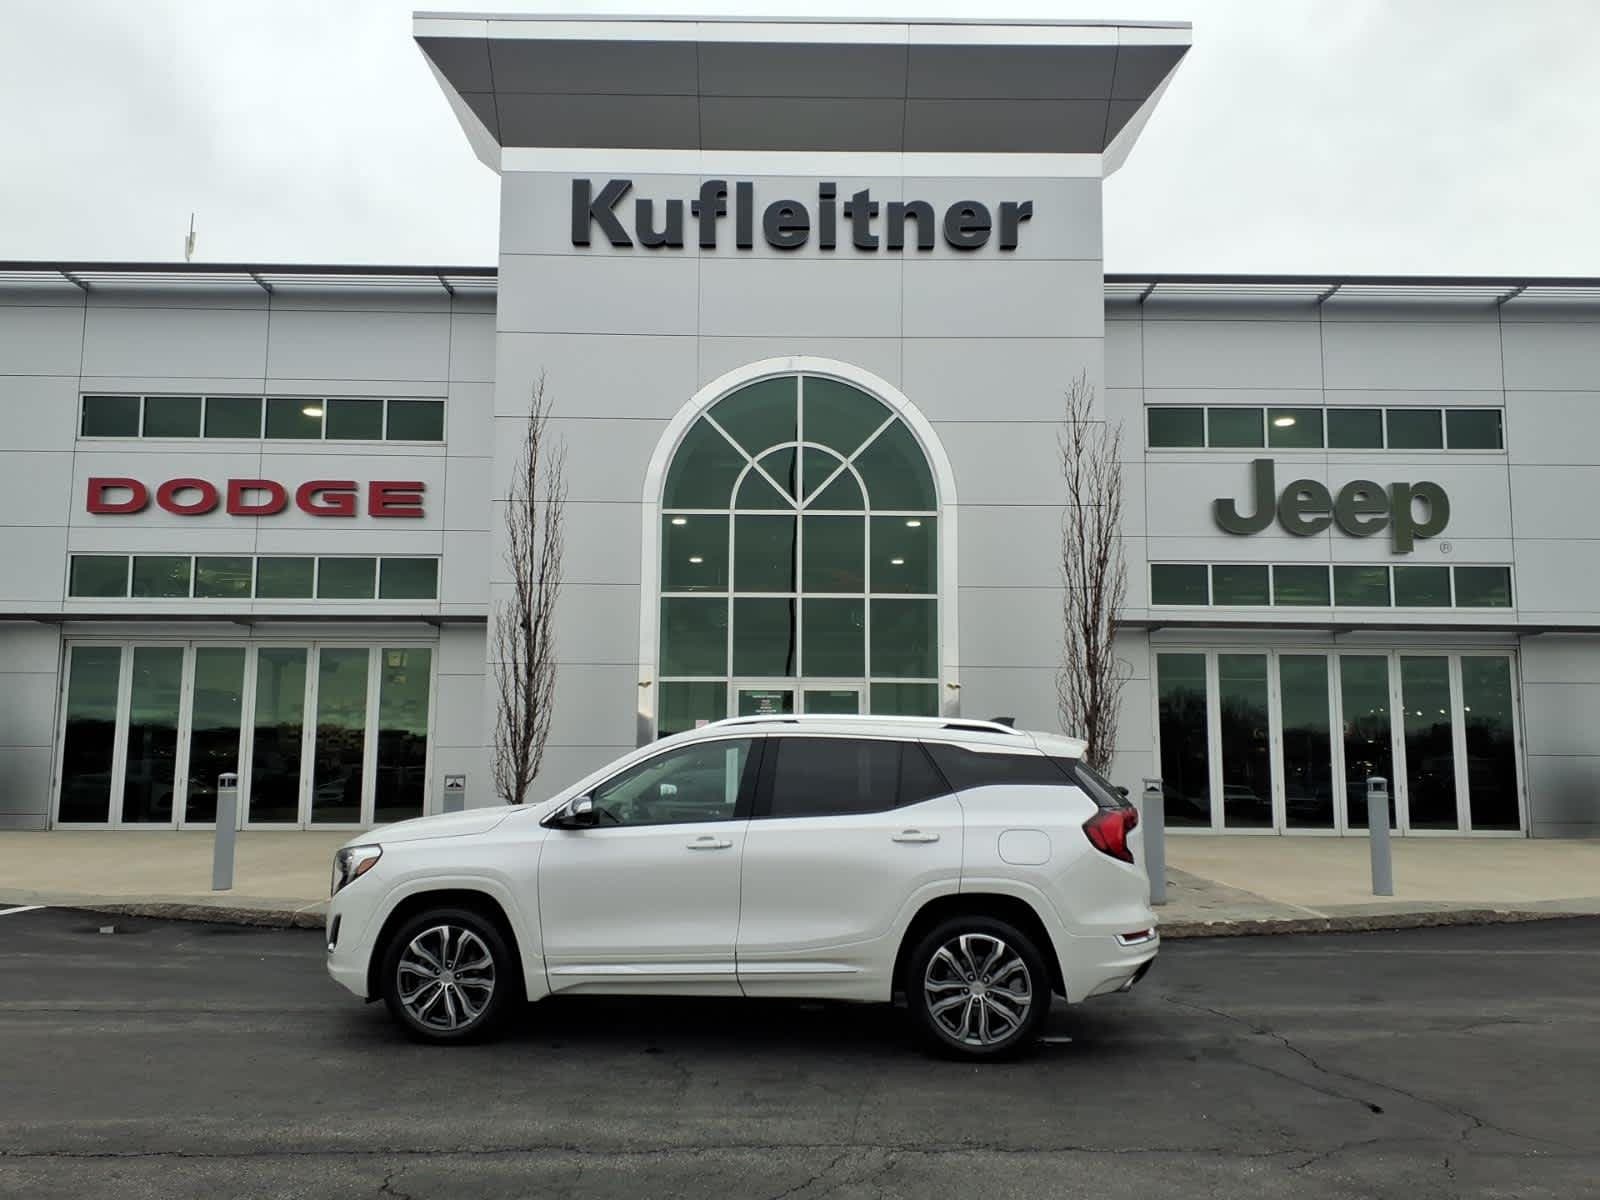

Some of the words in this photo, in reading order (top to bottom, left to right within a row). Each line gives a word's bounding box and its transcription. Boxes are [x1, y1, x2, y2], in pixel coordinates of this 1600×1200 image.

[572, 179, 1033, 250] Kufleitner
[87, 477, 425, 517] DODGE
[1214, 458, 1450, 554] Jeep
